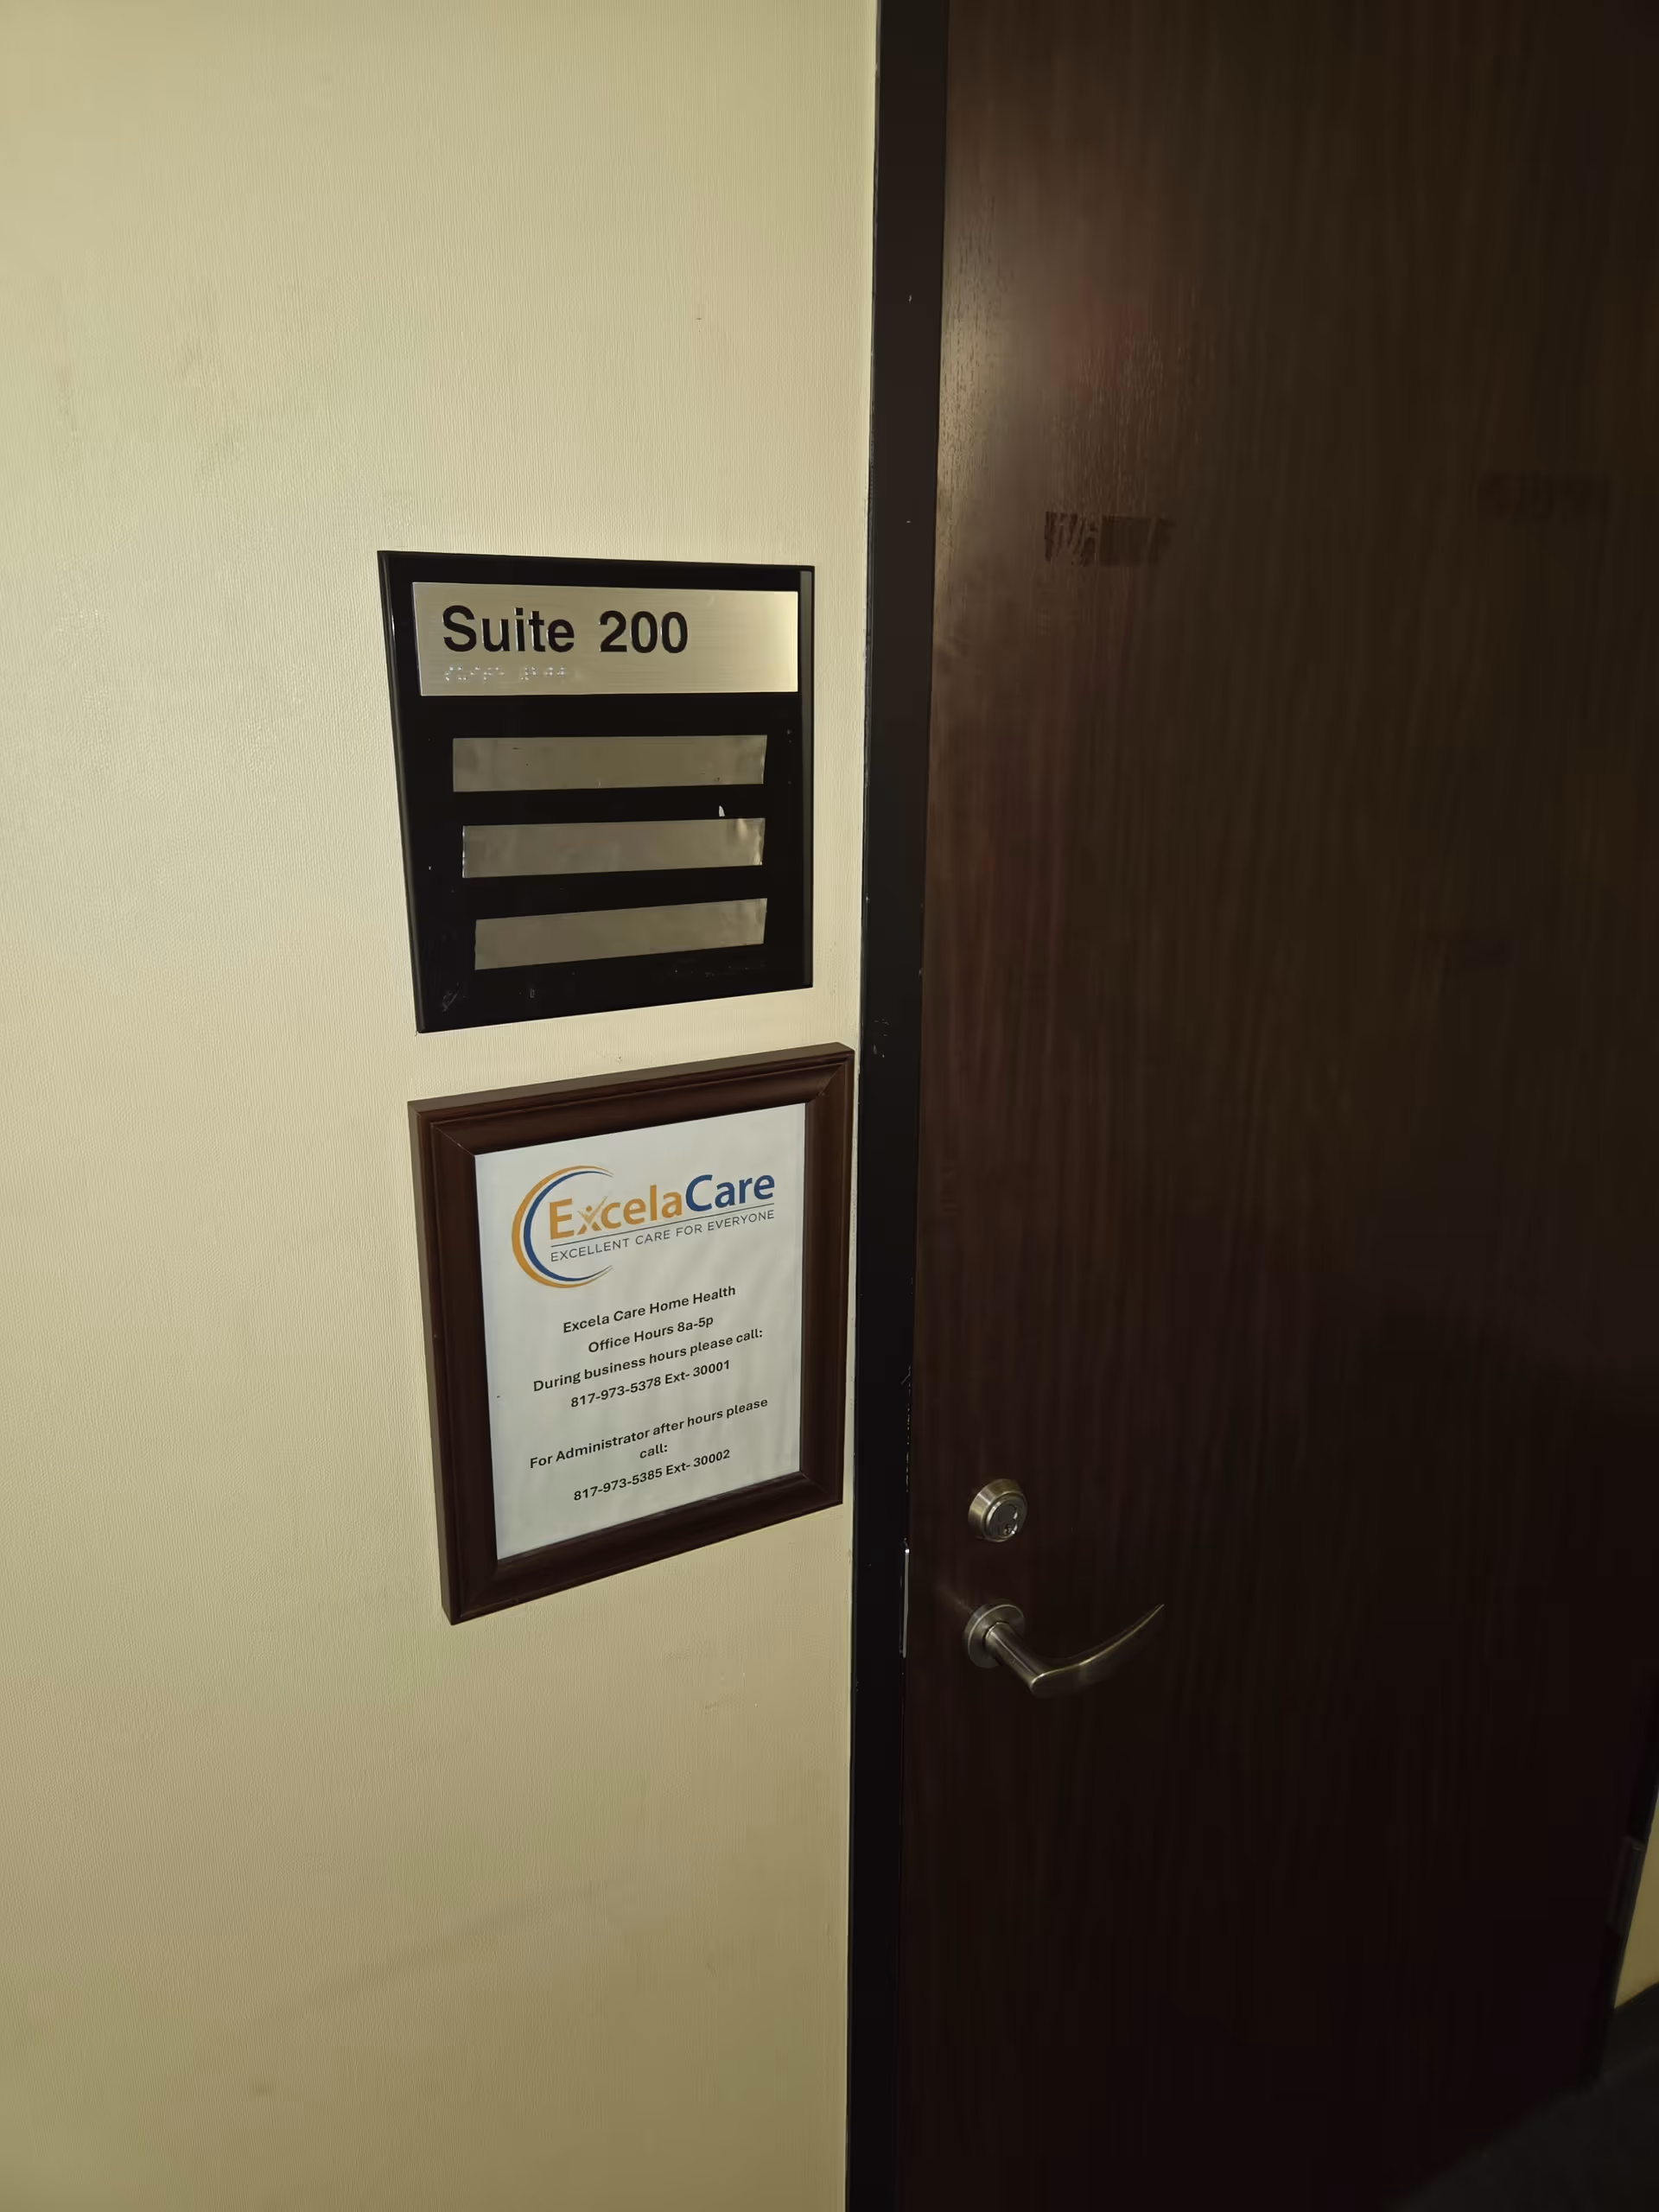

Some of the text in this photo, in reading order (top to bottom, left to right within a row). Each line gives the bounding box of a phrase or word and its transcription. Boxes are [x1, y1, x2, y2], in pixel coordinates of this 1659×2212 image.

[442, 604, 688, 653] Suite 200
[550, 1210, 775, 1262] EXCELLENT CARE FOR EVERYONE
[563, 1286, 736, 1333] Excela Care Home Health
[588, 1317, 714, 1353] Office Hours 8a-5p
[533, 1329, 763, 1391] During business hours please call:
[570, 1360, 729, 1408] 817-973-5378 Ext- 30001
[530, 1399, 768, 1468] For Administrator after hours please
[639, 1443, 668, 1459] call:
[574, 1450, 730, 1501] 817-973-5385 Ext- 30002
